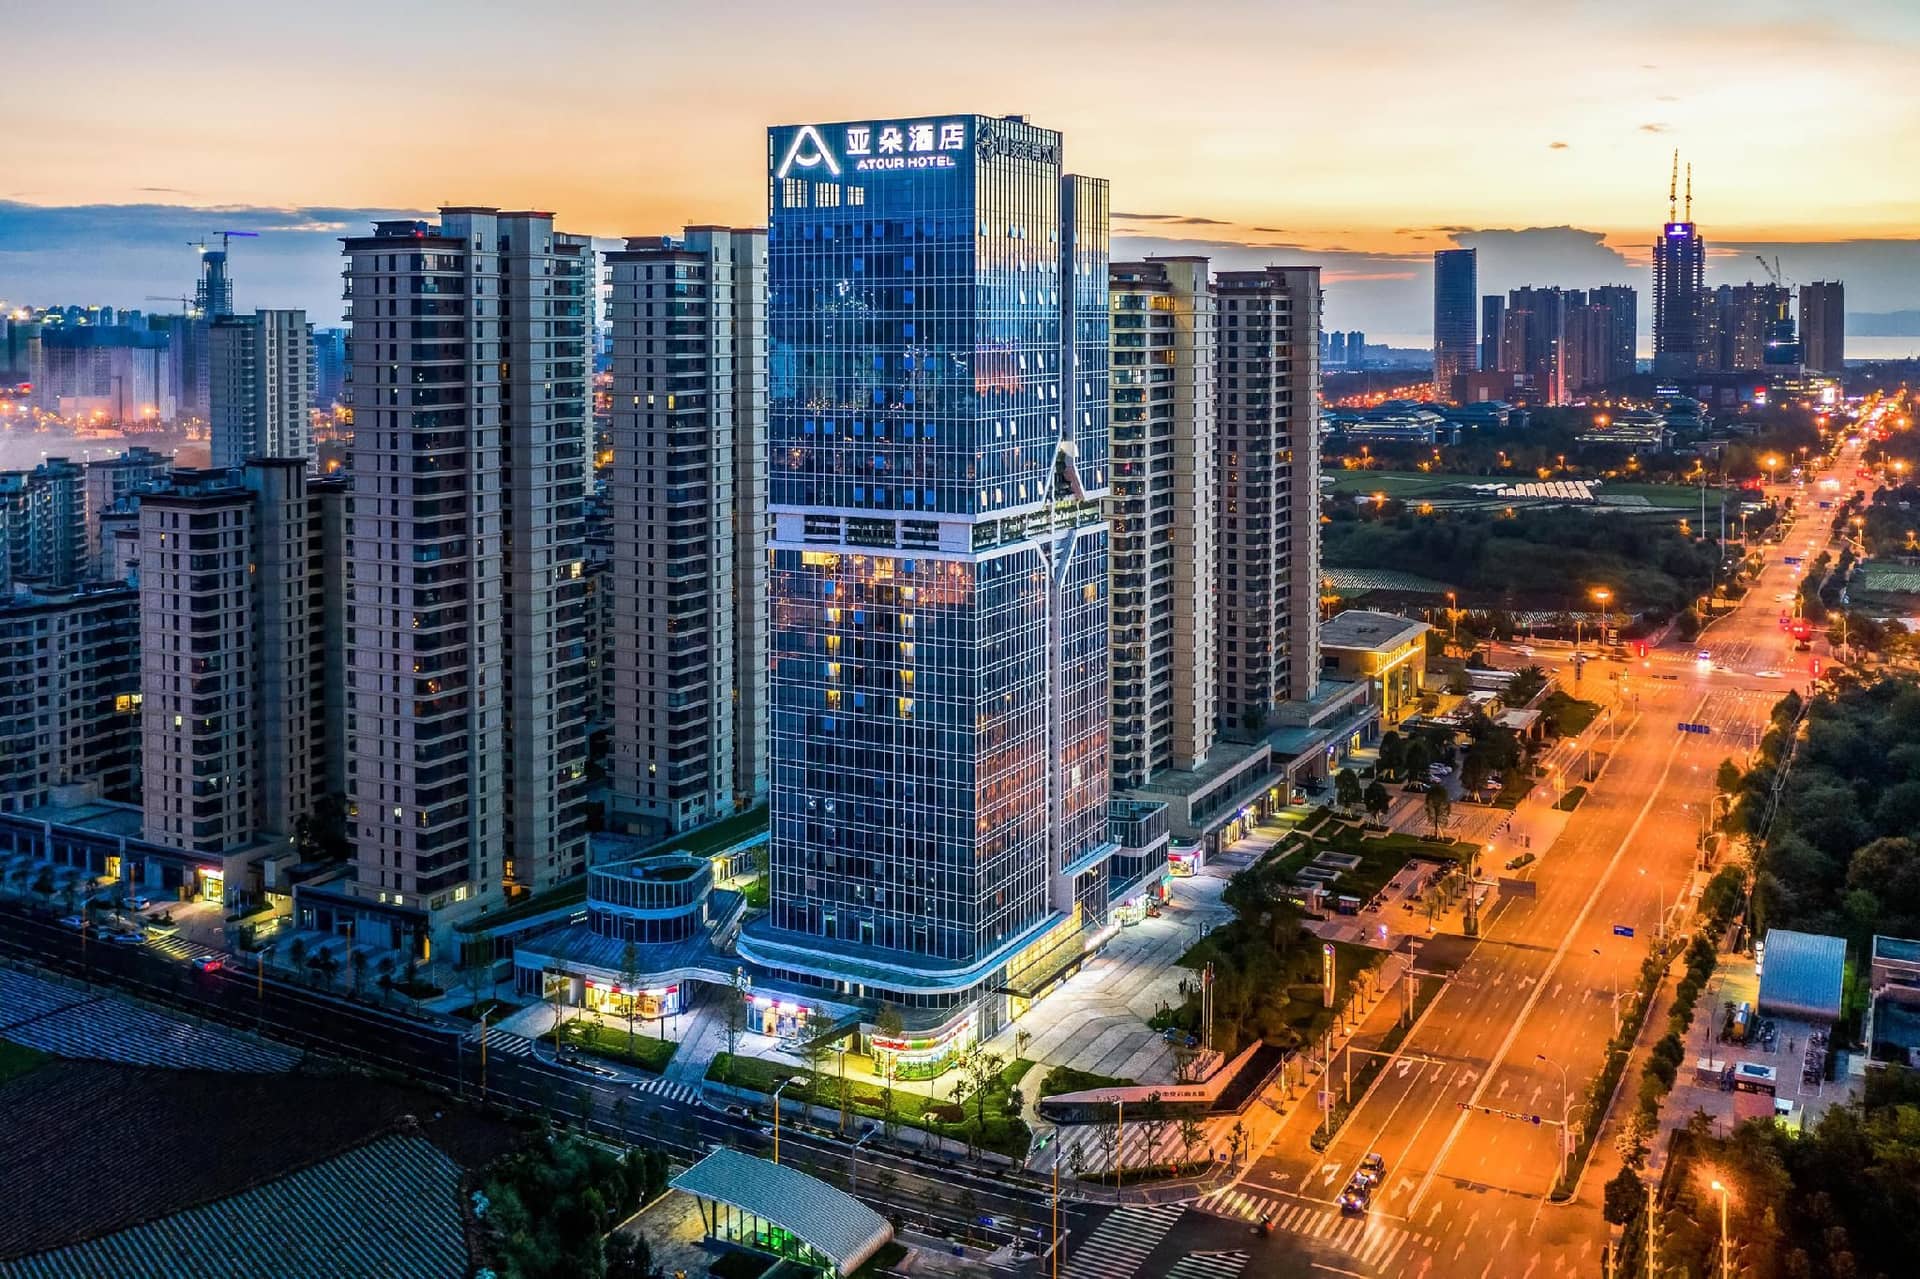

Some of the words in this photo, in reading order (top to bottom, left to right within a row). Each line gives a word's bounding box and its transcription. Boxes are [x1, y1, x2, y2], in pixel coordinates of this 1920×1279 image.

[846, 124, 964, 155] 亚朵酒店
[857, 158, 905, 171] ATOUR
[907, 155, 957, 168] HOTEL
